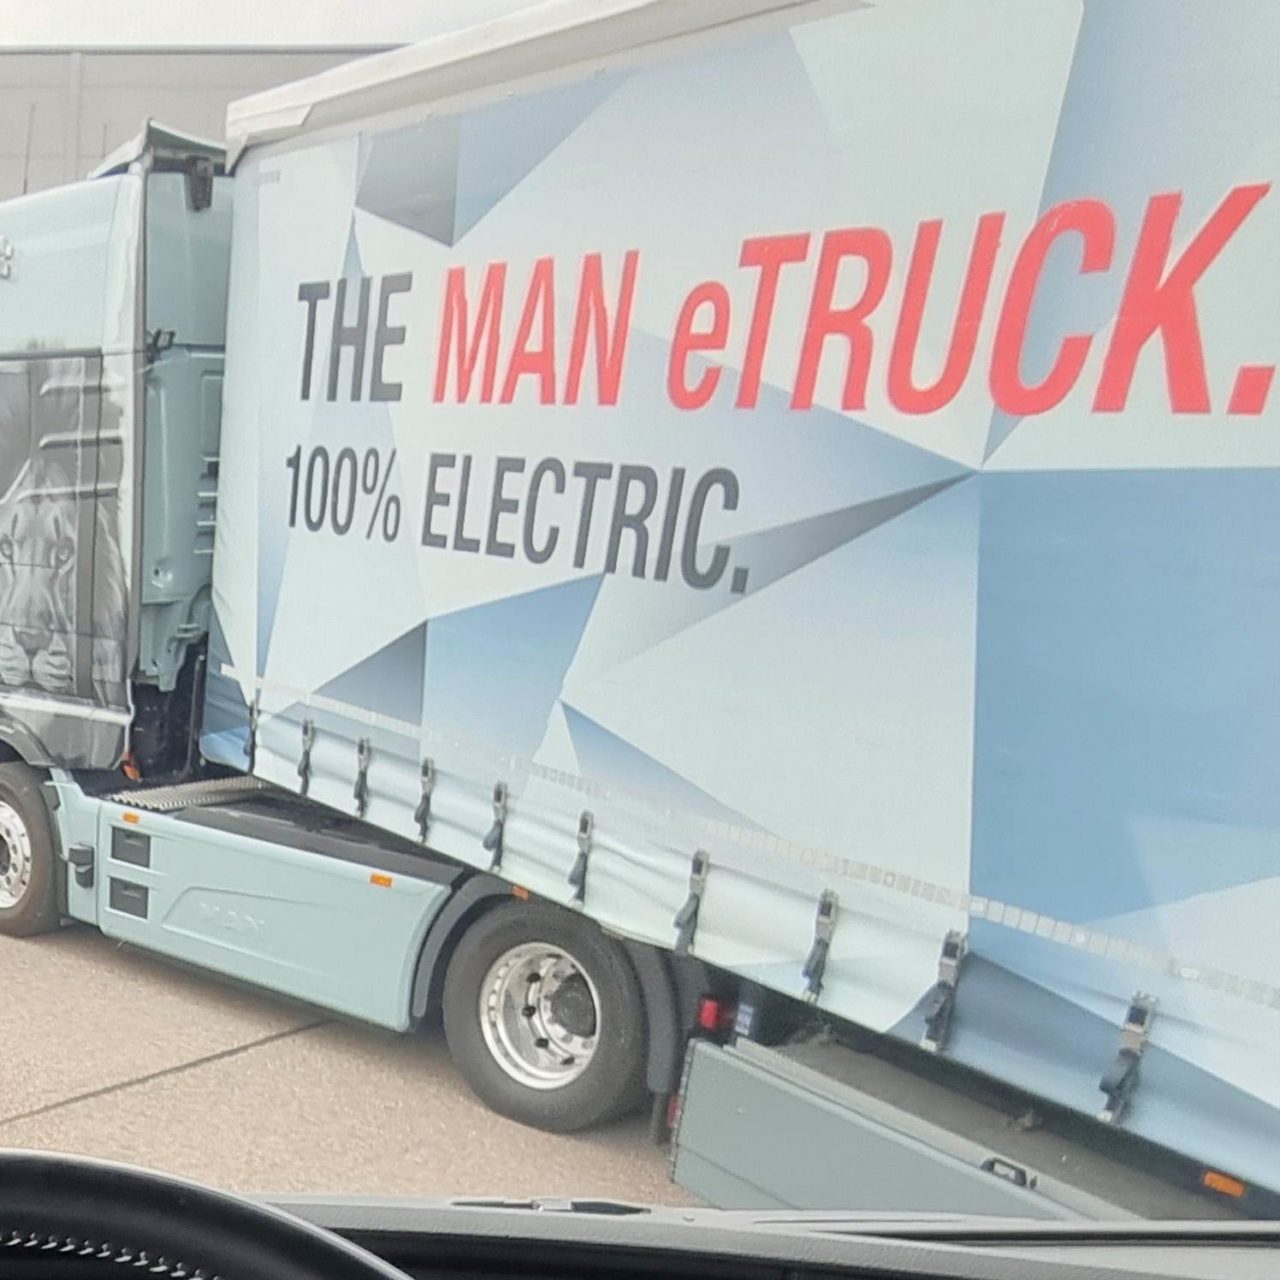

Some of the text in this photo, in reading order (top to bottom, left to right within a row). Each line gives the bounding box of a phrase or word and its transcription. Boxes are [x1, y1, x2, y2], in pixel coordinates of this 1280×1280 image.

[297, 180, 1276, 416] THE MAN eTRUCK.
[285, 444, 749, 595] 100% ELECTRIC.
